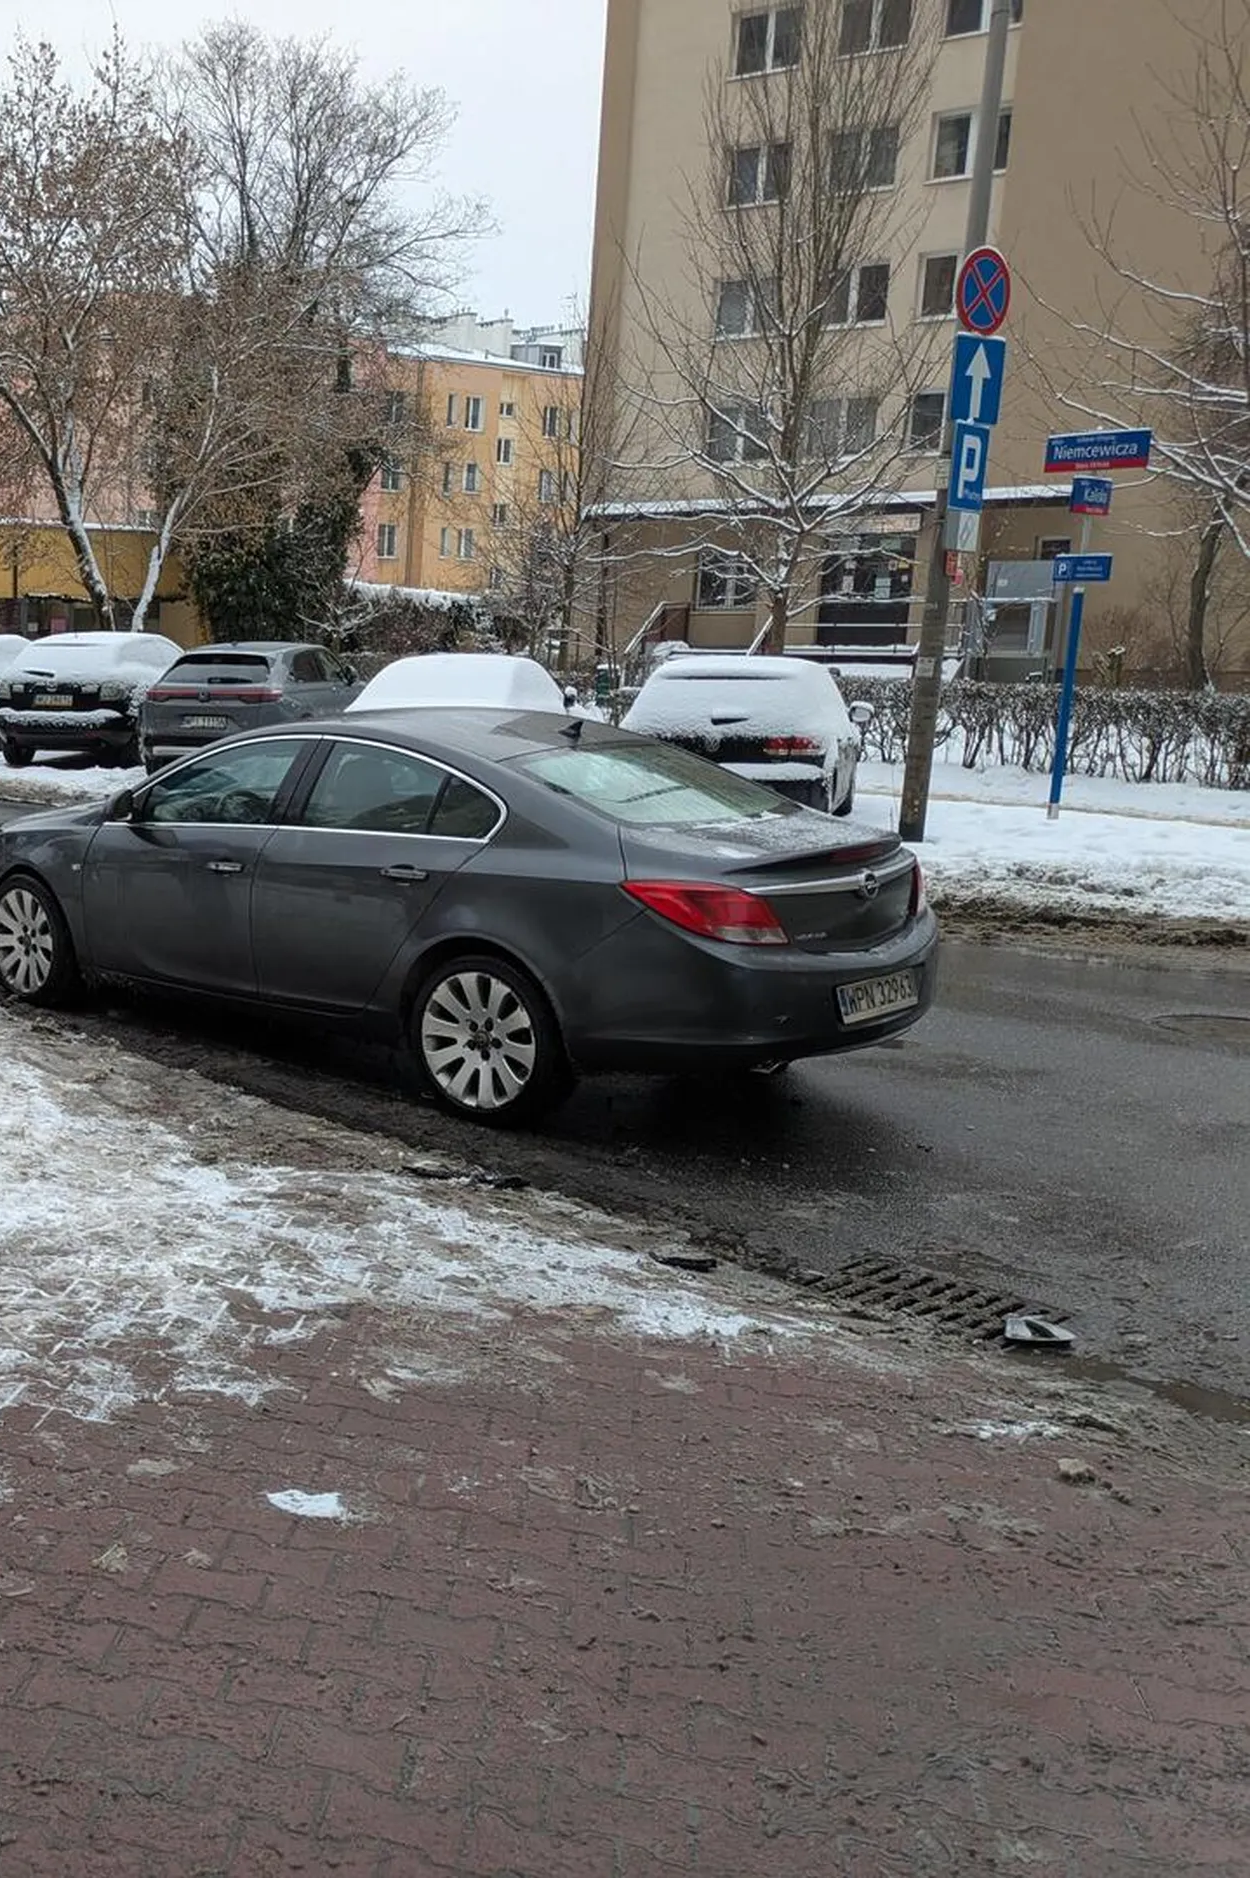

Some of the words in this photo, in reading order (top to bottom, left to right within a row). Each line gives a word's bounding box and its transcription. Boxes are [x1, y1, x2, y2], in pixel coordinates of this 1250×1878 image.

[1053, 442, 1138, 460] Niemcewicza
[957, 434, 982, 499] P
[1058, 562, 1067, 576] P
[847, 983, 876, 1015] WPN
